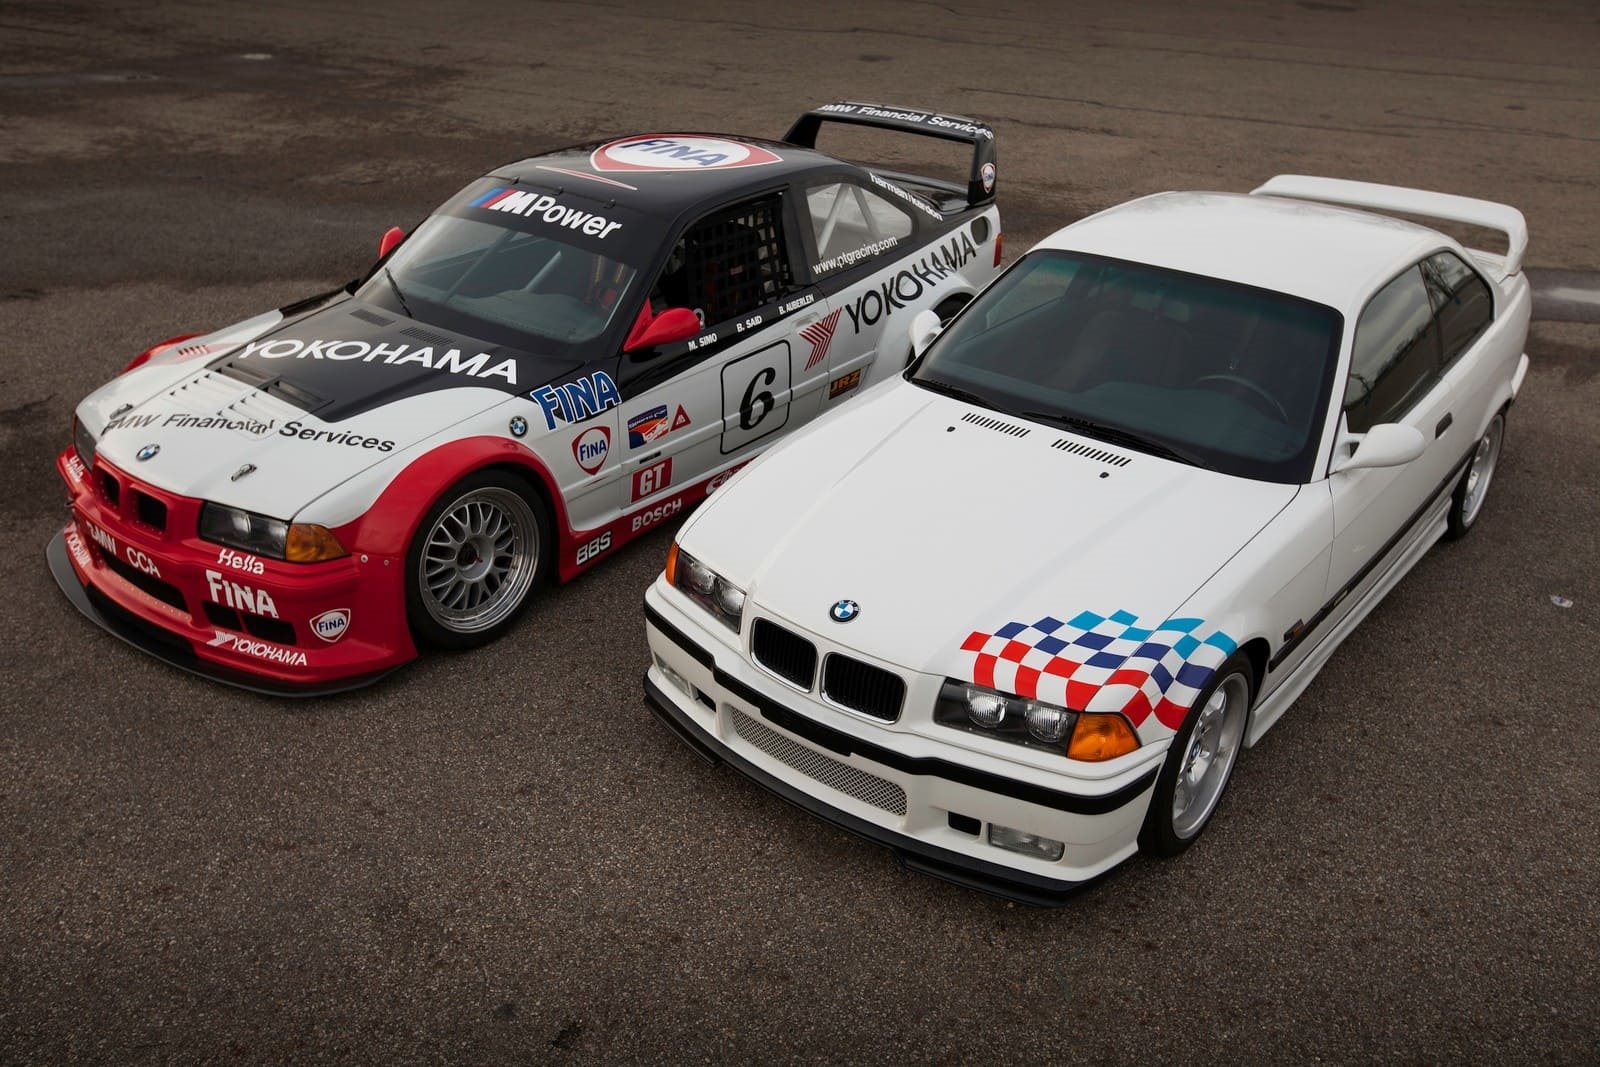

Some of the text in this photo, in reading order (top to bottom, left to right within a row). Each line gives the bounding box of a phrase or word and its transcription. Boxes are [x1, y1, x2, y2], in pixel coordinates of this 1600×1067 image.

[857, 107, 926, 123] Financial
[928, 116, 994, 140] Services
[619, 139, 730, 167] FINA
[812, 235, 898, 275] www.ptgracing.com
[845, 231, 978, 335] YOKOHAMA
[745, 315, 762, 330] SAID
[688, 332, 718, 352] M. SIMO
[238, 339, 518, 385] YOKOHAMA
[530, 370, 622, 432] FINA
[739, 366, 776, 431] 6
[279, 421, 396, 452] Services
[579, 438, 607, 462] FINA
[639, 462, 665, 496] GT
[631, 497, 682, 533] BOSCH
[126, 547, 161, 578] CCA
[217, 549, 265, 575] Hella
[576, 531, 612, 565] BBS
[205, 569, 280, 619] FINA
[318, 618, 345, 633] FINA
[232, 637, 308, 666] YOKOHAMA
